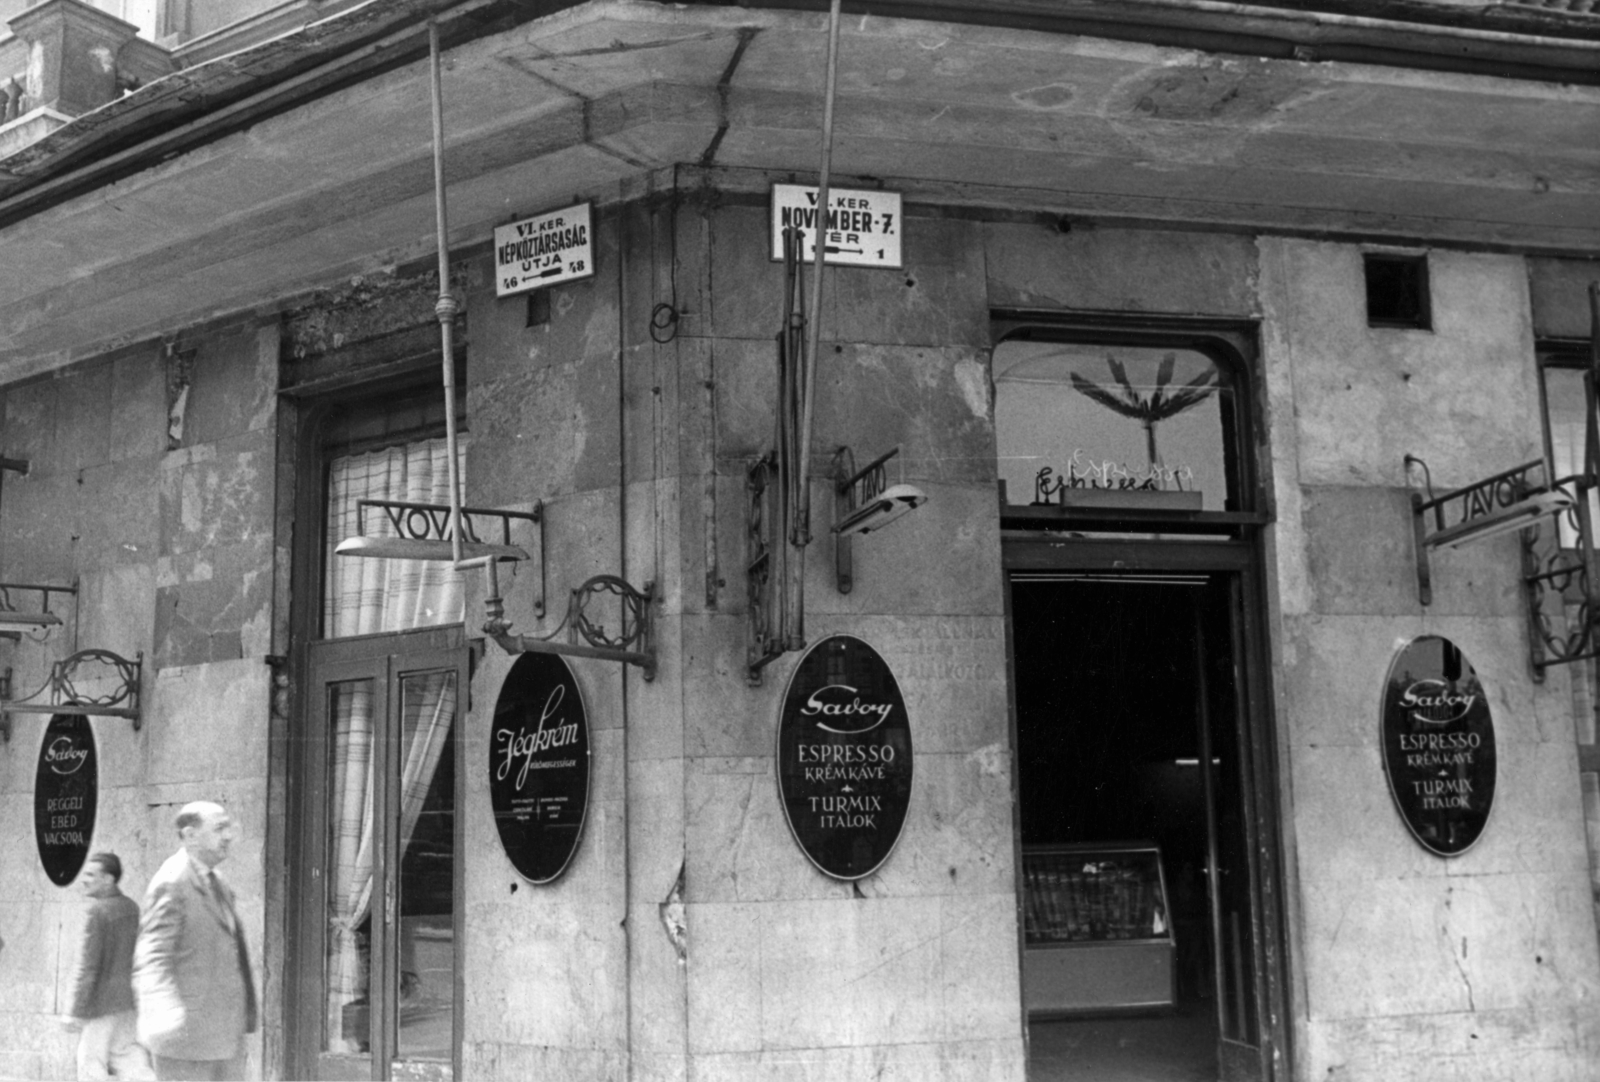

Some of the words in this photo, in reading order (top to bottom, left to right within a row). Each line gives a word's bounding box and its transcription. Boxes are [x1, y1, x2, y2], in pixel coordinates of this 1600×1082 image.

[805, 192, 833, 207] V.
[837, 197, 873, 210] KER.
[516, 222, 537, 237] VI.
[539, 217, 566, 232] KER.
[499, 224, 587, 267] NÉPKÖZTÁRSASÁG
[823, 230, 860, 245] ÉR
[876, 248, 885, 260] 1
[801, 684, 893, 734] Savoy
[1399, 679, 1476, 724] Savoy
[497, 684, 579, 791] Jégkrém
[1400, 732, 1480, 750] ESPRESSO
[45, 736, 88, 775] Savoy
[798, 744, 895, 765] ESPRESSO
[804, 762, 886, 783] KRÉMKÁVÉ
[1412, 779, 1473, 795] TURMIX
[808, 796, 881, 814] TURMIX
[1423, 796, 1471, 810] ITALOK
[51, 811, 78, 829] EBÉD
[820, 814, 877, 829] ITALOK
[44, 831, 84, 846] VACSORA
